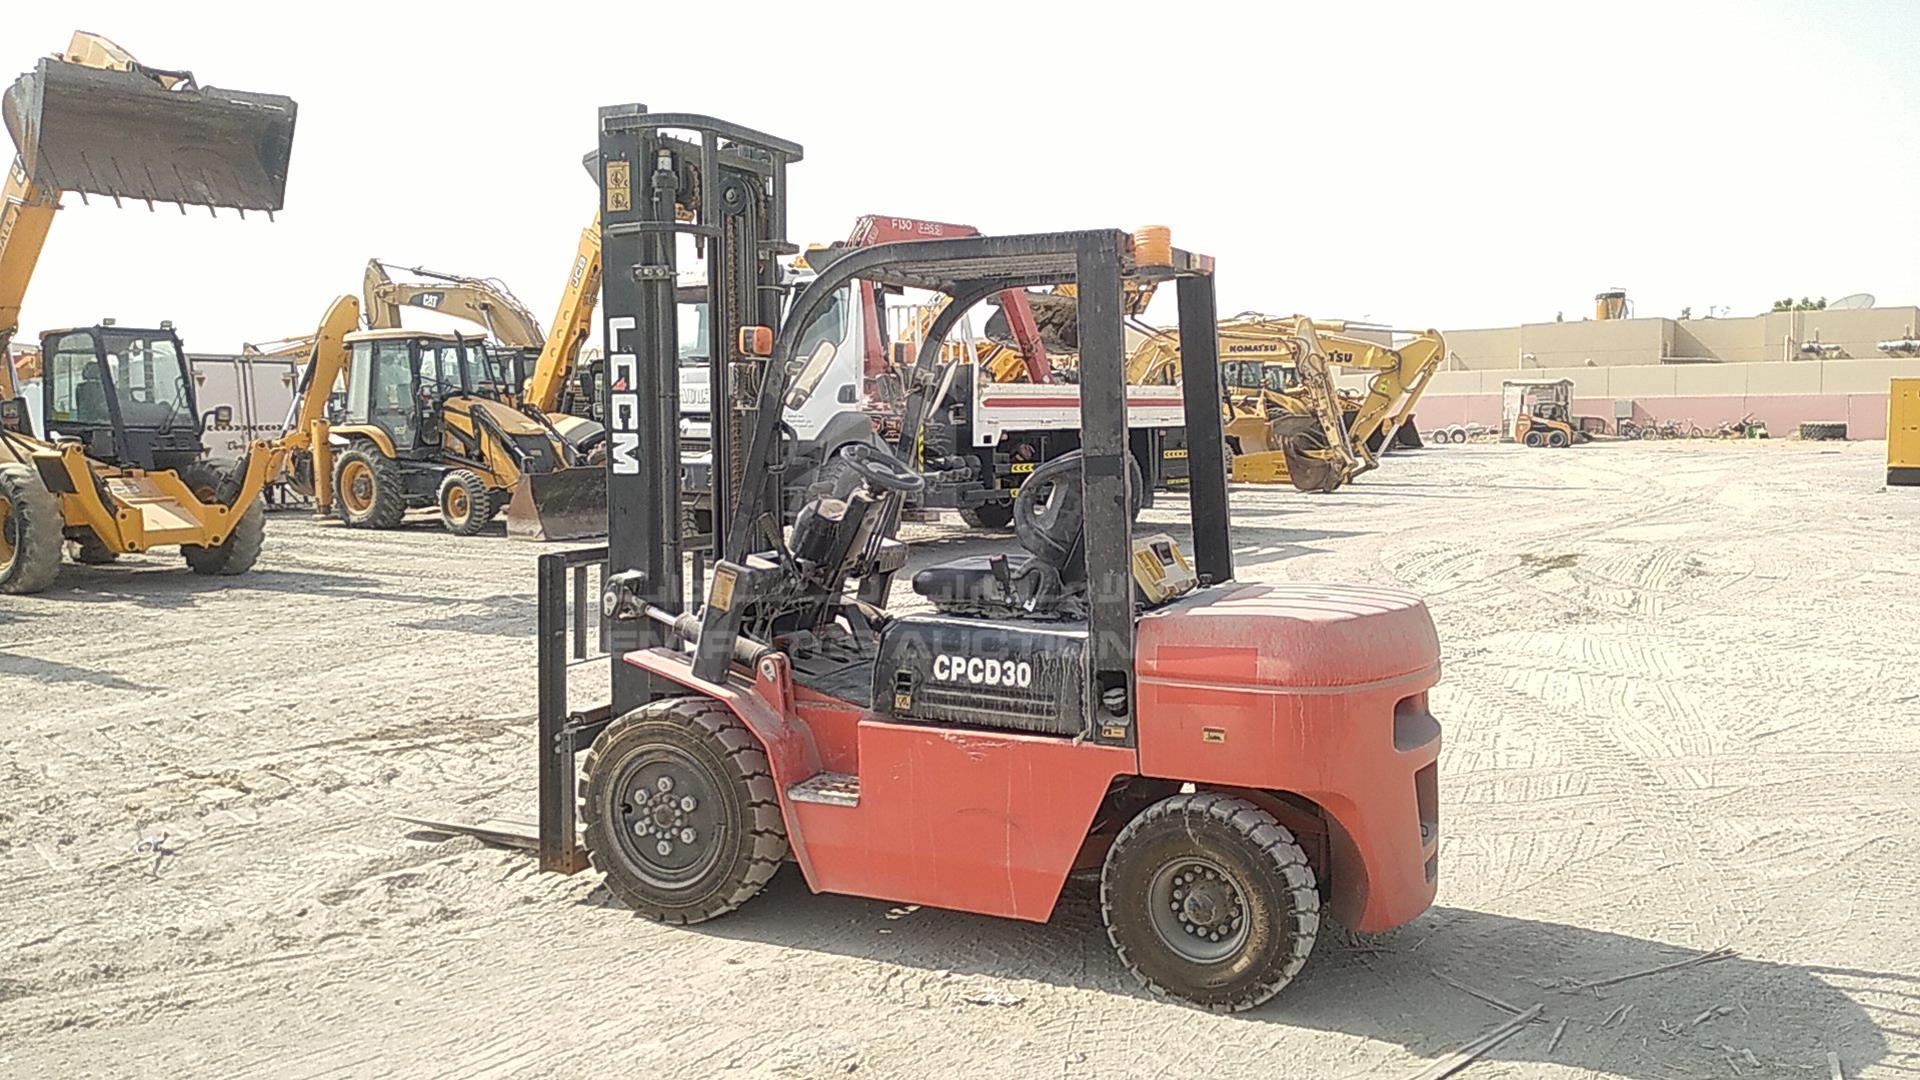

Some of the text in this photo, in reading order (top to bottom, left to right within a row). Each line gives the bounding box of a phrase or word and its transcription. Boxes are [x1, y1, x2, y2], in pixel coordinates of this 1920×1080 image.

[571, 255, 587, 288] JCB
[423, 294, 438, 308] CAT
[1229, 344, 1278, 353] KOMATSU
[1326, 351, 1353, 363] TSU
[608, 317, 640, 475] LGCM
[932, 653, 1032, 689] CPCD30
